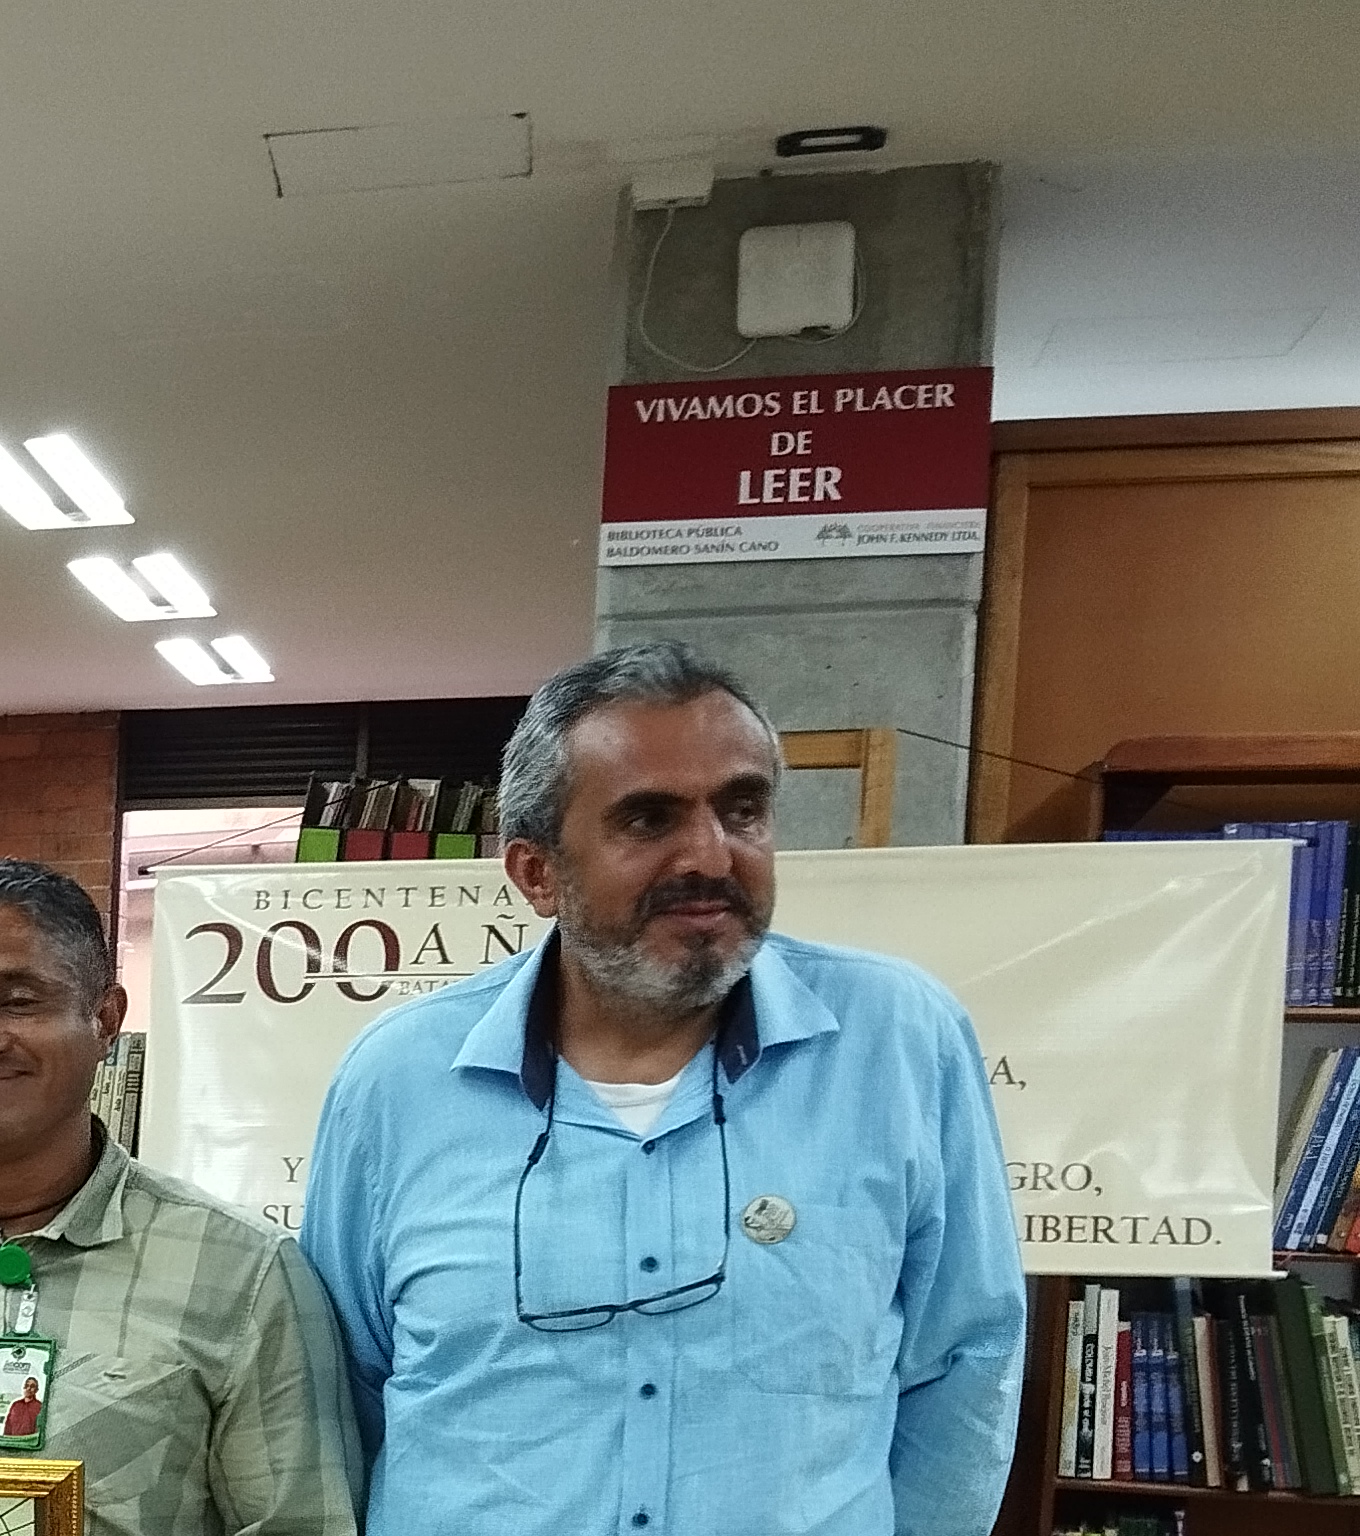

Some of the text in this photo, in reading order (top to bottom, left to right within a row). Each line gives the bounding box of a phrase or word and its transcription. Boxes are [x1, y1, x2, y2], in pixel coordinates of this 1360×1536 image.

[635, 383, 956, 423] VIVAMOS EL PLACER
[770, 430, 813, 457] DE
[737, 466, 843, 506] LEER
[607, 525, 743, 541] BIBLIOTECA PÚBLICA
[856, 533, 888, 546] JOHN
[900, 531, 949, 543] KENNEDY
[606, 540, 780, 558] BALDOMERO SANÍN CANO
[253, 885, 531, 911] BICENTENA
[181, 919, 401, 1004] 200
[983, 1056, 1027, 1090] A,
[282, 1156, 305, 1183] Y
[1018, 1214, 1221, 1245] IBERTAD.
